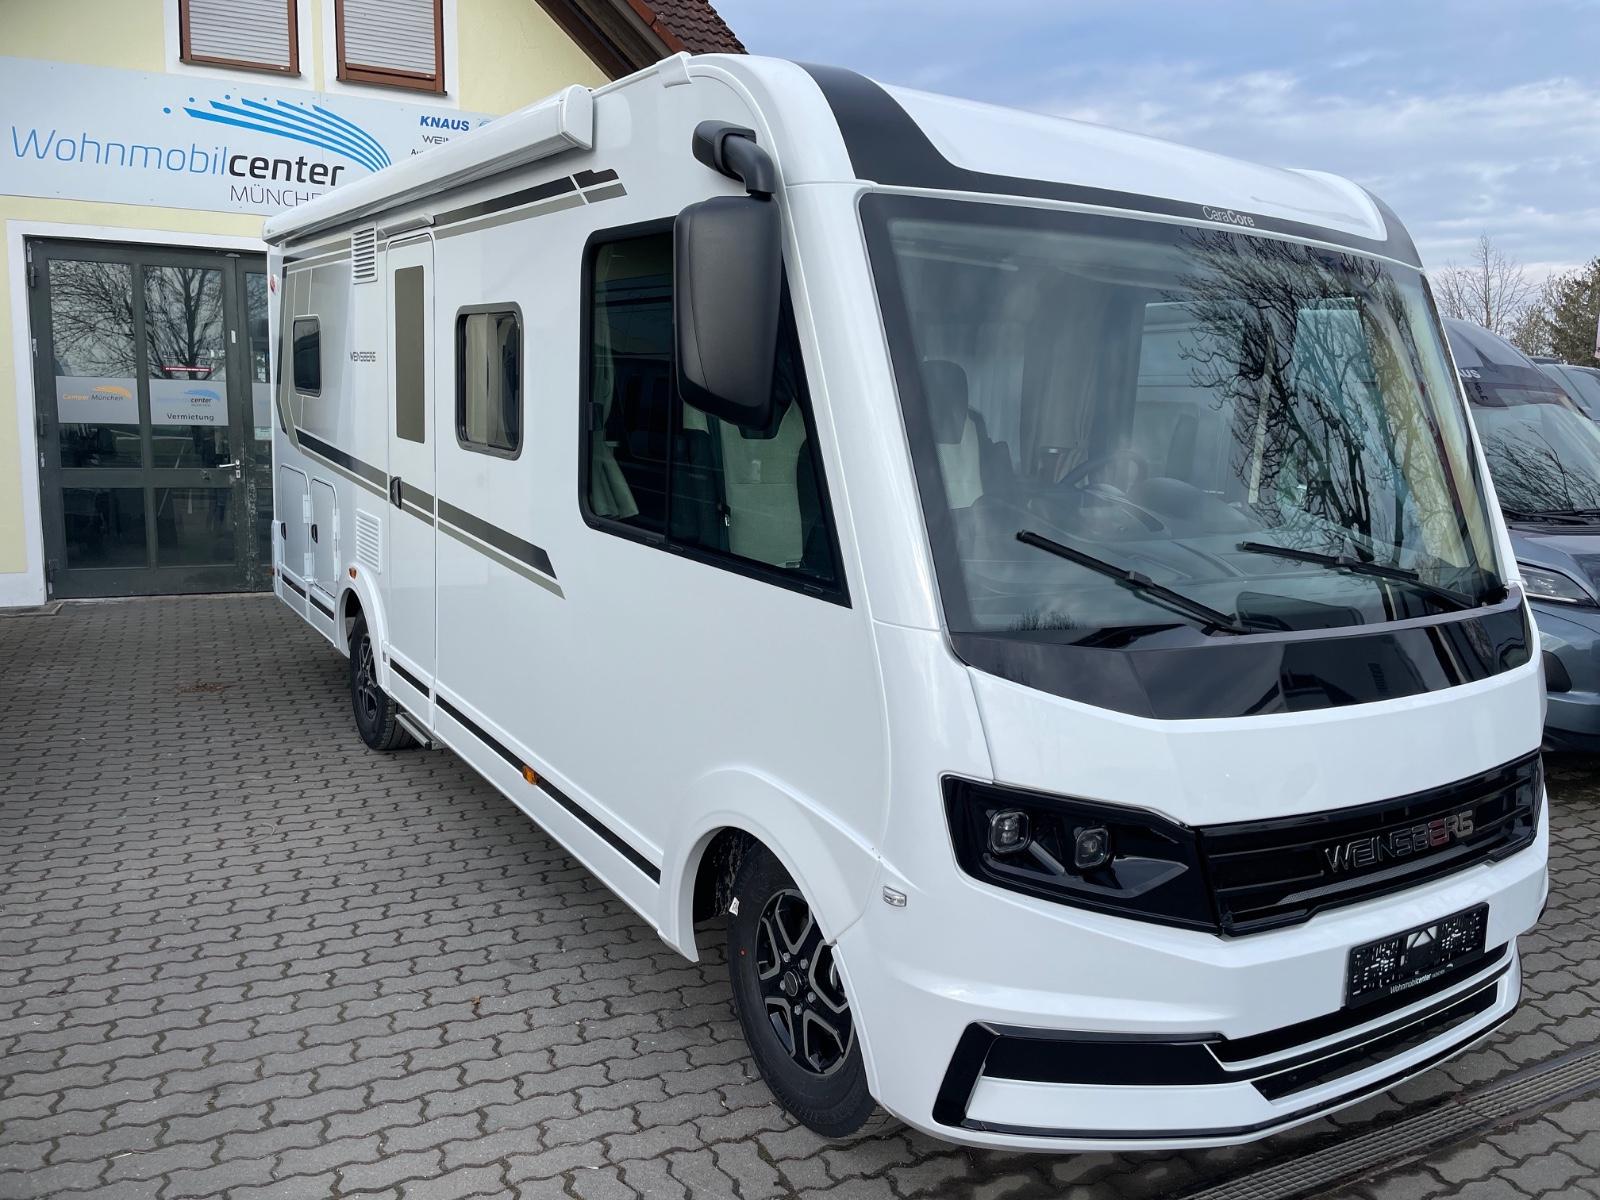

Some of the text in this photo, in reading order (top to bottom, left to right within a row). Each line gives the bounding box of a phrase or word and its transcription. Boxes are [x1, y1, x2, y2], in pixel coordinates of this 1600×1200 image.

[420, 115, 470, 132] KNAUS
[11, 125, 345, 187] Wohnmobilcenter
[1202, 205, 1255, 227] CaraCore
[166, 412, 215, 422] Vermietung
[1324, 809, 1474, 873] WEINSBERG
